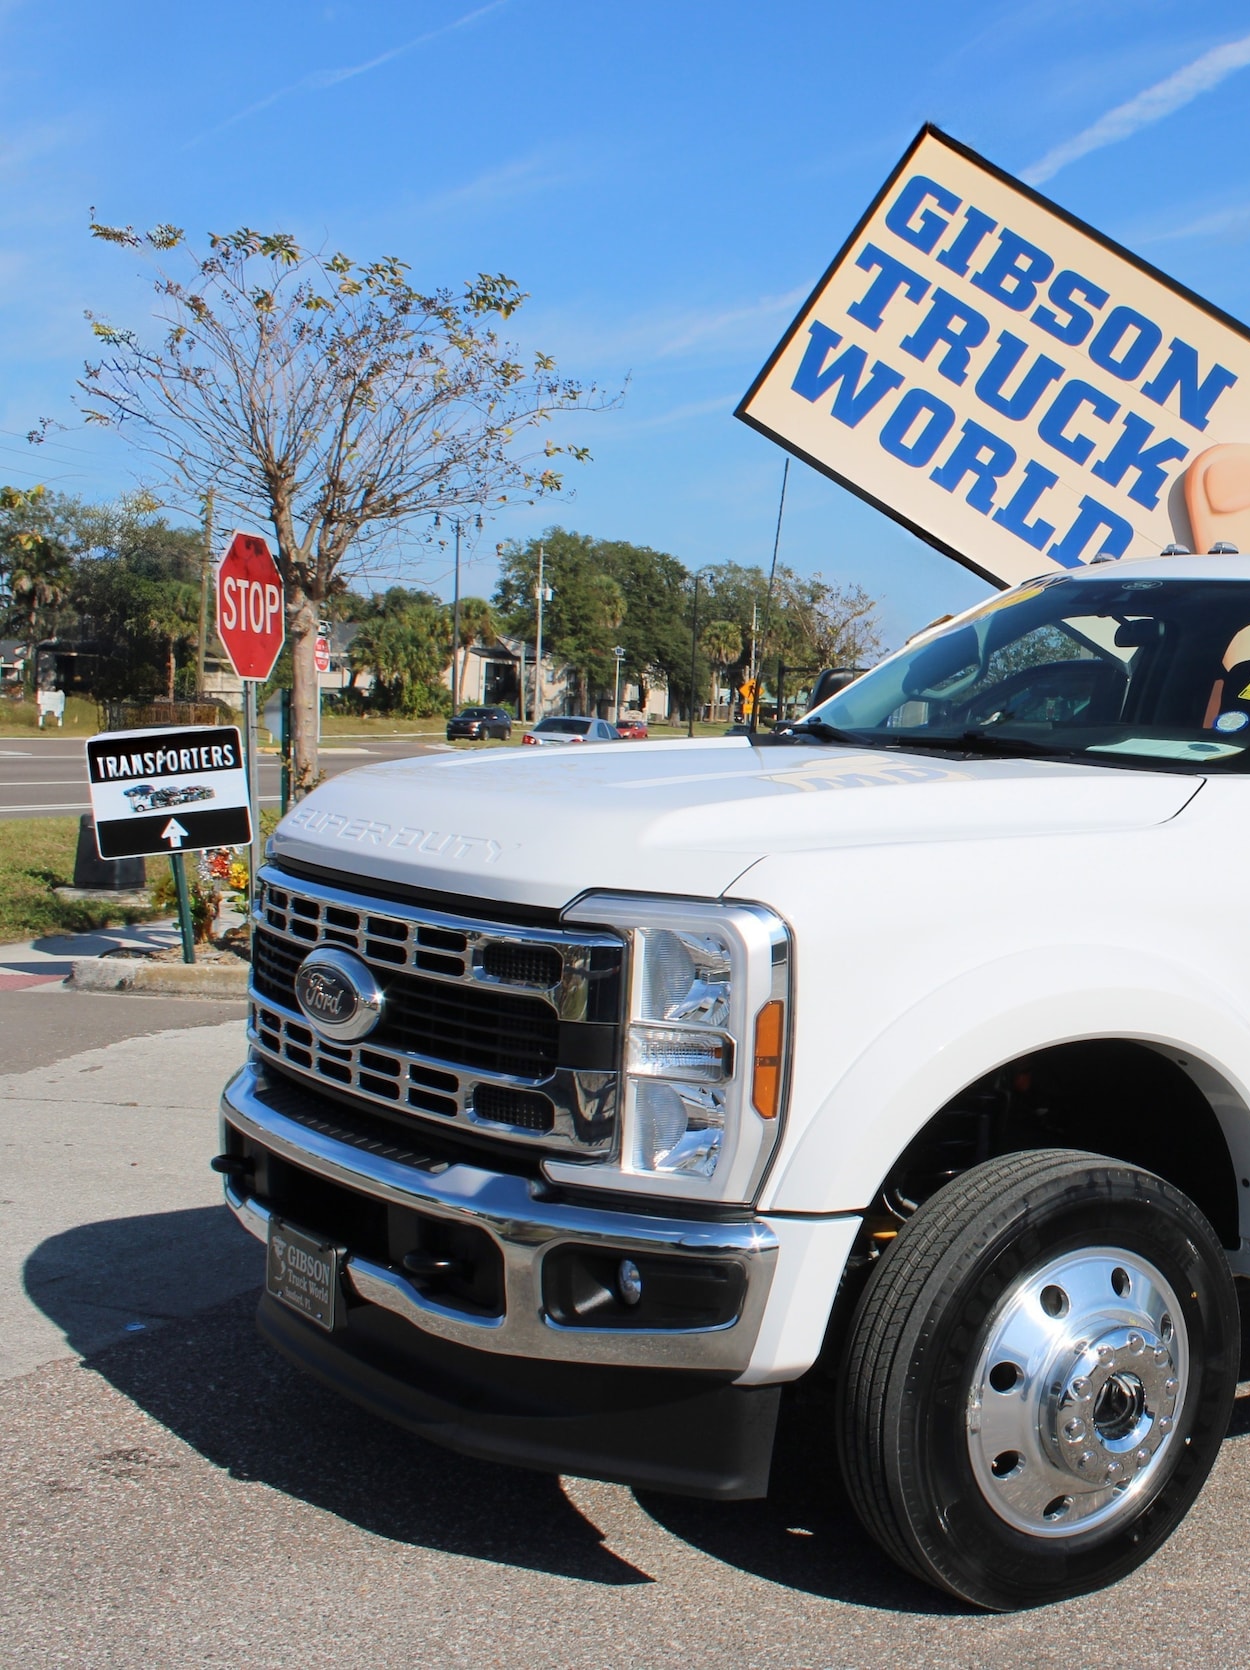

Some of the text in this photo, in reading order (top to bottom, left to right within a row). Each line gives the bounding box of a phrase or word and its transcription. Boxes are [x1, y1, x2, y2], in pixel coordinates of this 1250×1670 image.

[884, 174, 1238, 431] GIBSON
[846, 242, 1189, 510] TRUCK
[790, 319, 1135, 569] WORLD
[222, 576, 280, 635] STOP
[96, 744, 235, 779] TRANSPORTERS
[289, 807, 503, 864] SUPER DUTY
[305, 972, 345, 1015] Ford
[287, 1245, 331, 1287] GIBSON
[287, 1268, 329, 1304] Truck World
